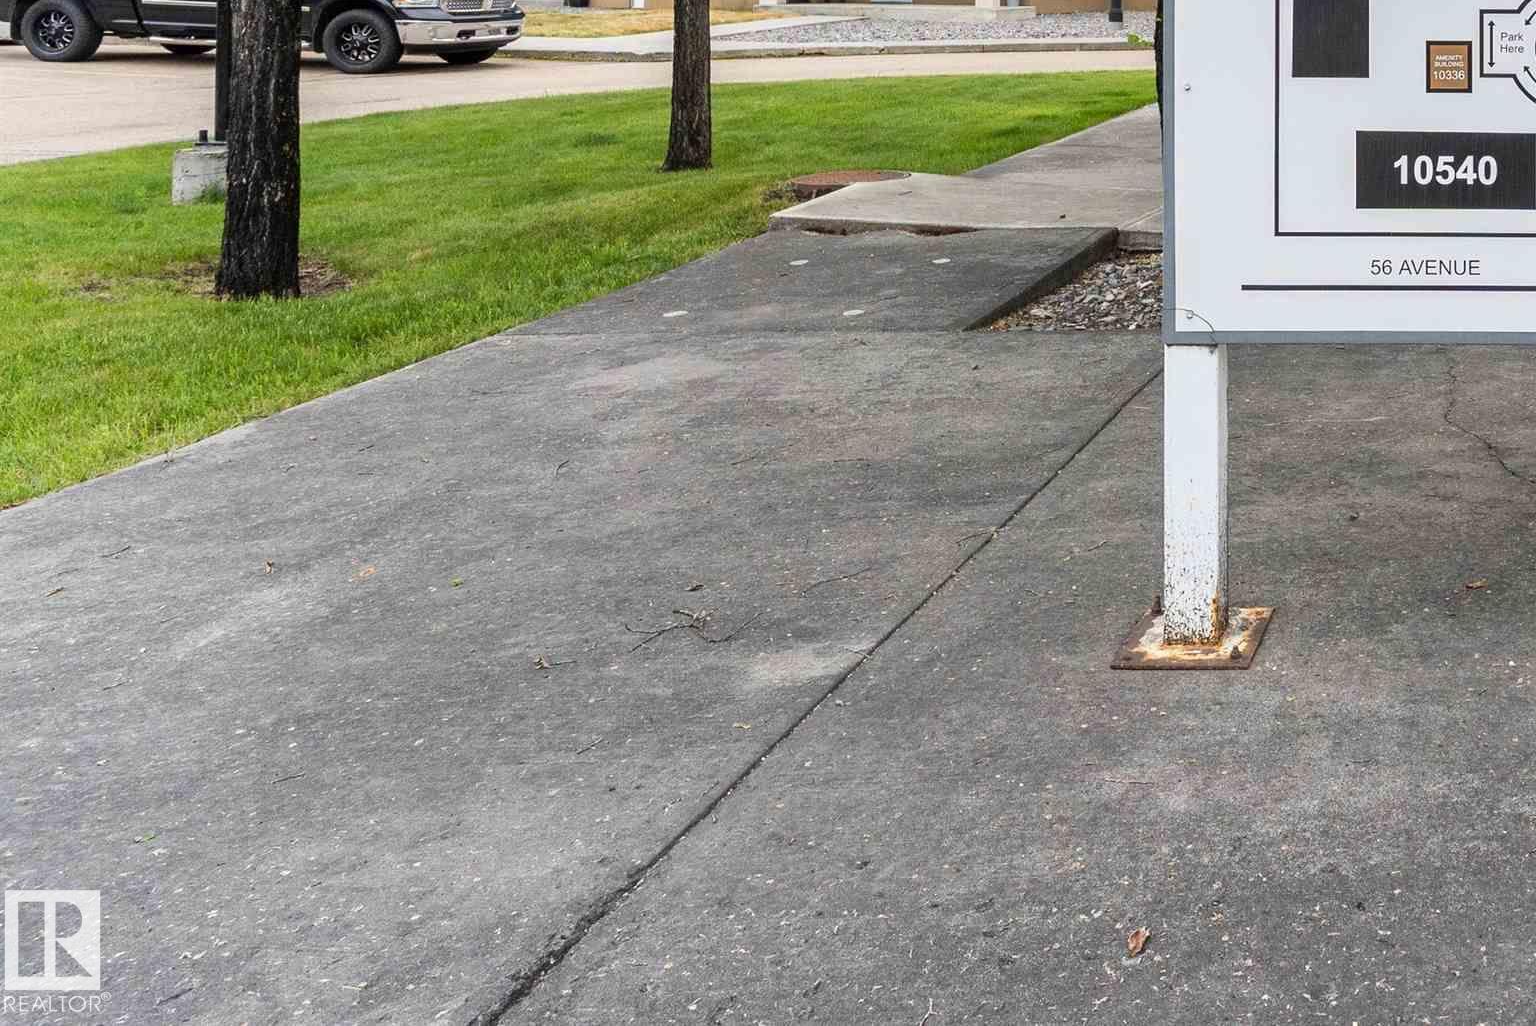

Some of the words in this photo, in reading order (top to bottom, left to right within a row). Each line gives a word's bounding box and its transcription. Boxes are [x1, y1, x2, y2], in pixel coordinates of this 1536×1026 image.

[1500, 31, 1524, 42] Park
[1500, 43, 1525, 54] Here
[1433, 70, 1465, 80] 10336
[1392, 154, 1499, 186] 10540
[1370, 259, 1393, 276] 56
[1398, 259, 1481, 277] AVENUE
